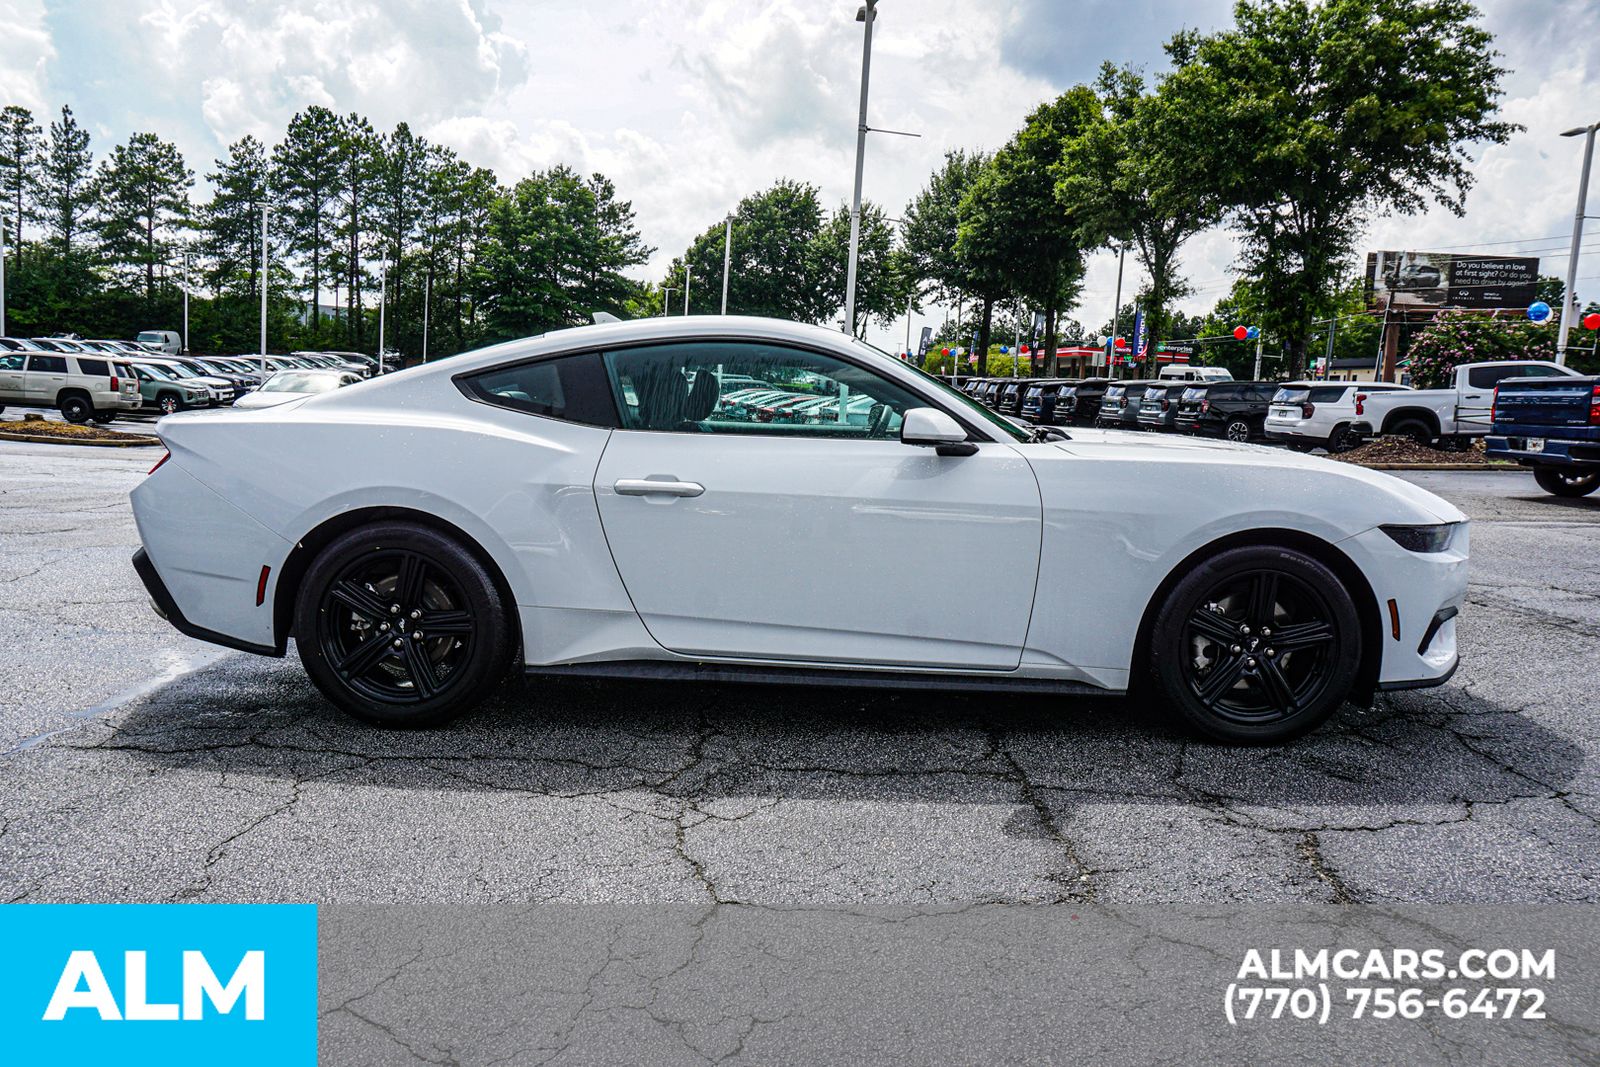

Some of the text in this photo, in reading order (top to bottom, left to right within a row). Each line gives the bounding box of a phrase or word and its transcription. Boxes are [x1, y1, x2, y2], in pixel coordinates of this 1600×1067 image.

[1481, 262, 1504, 270] believe
[1478, 270, 1499, 278] sight?
[1498, 279, 1506, 287] by
[1158, 345, 1193, 353] enterprise
